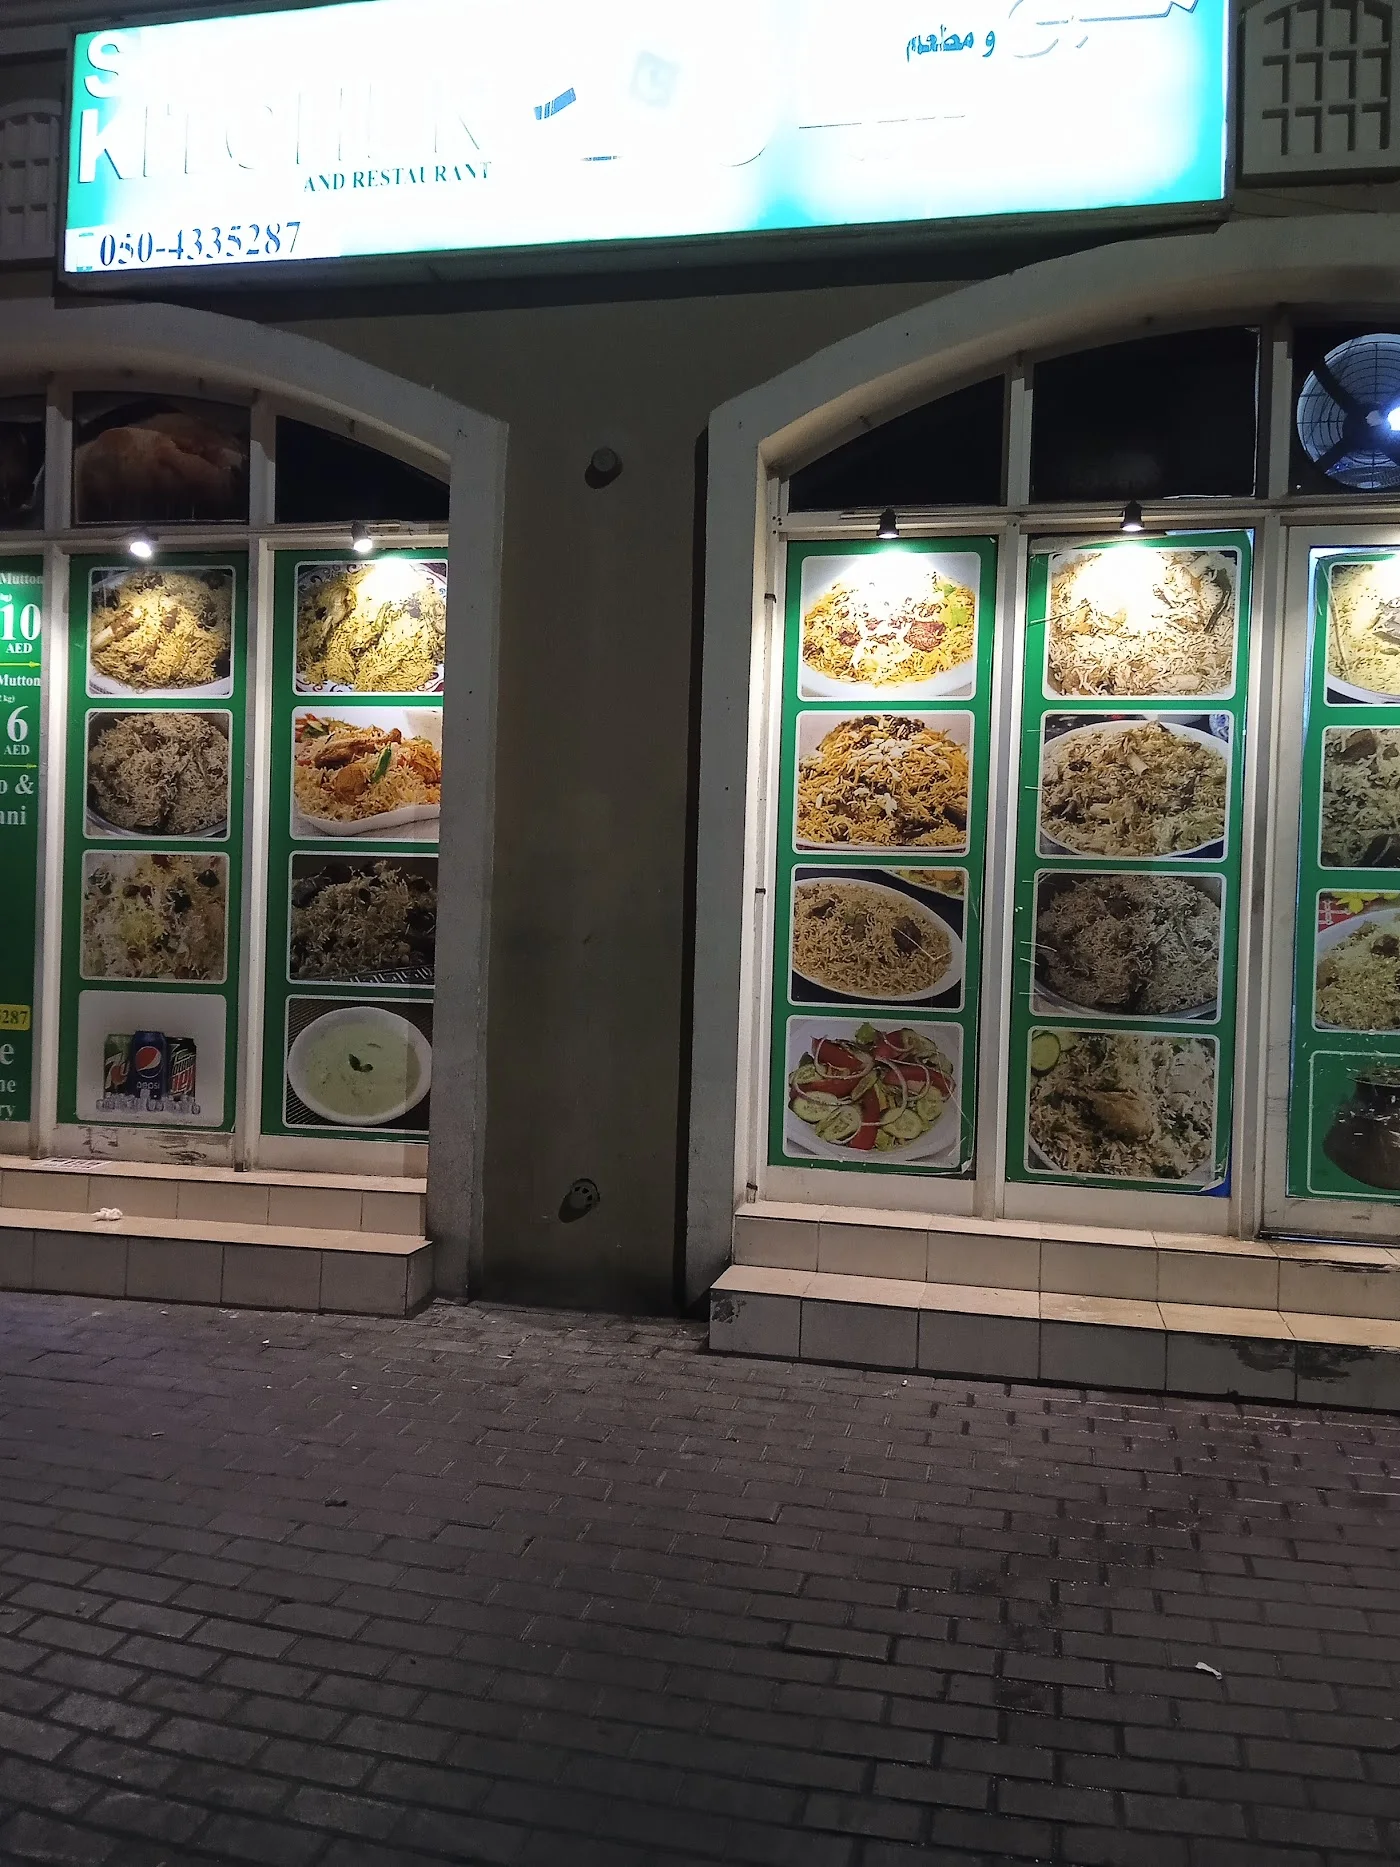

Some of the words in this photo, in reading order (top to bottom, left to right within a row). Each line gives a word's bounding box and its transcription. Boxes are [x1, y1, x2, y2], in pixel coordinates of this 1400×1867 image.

[303, 173, 345, 192] AND
[353, 161, 492, 188] RESTAURANT
[100, 221, 301, 266] 050-4335287
[0, 603, 41, 640] 10
[6, 642, 33, 654] AED
[7, 705, 29, 742] 6
[4, 744, 30, 755] AED
[0, 1009, 28, 1024] 287
